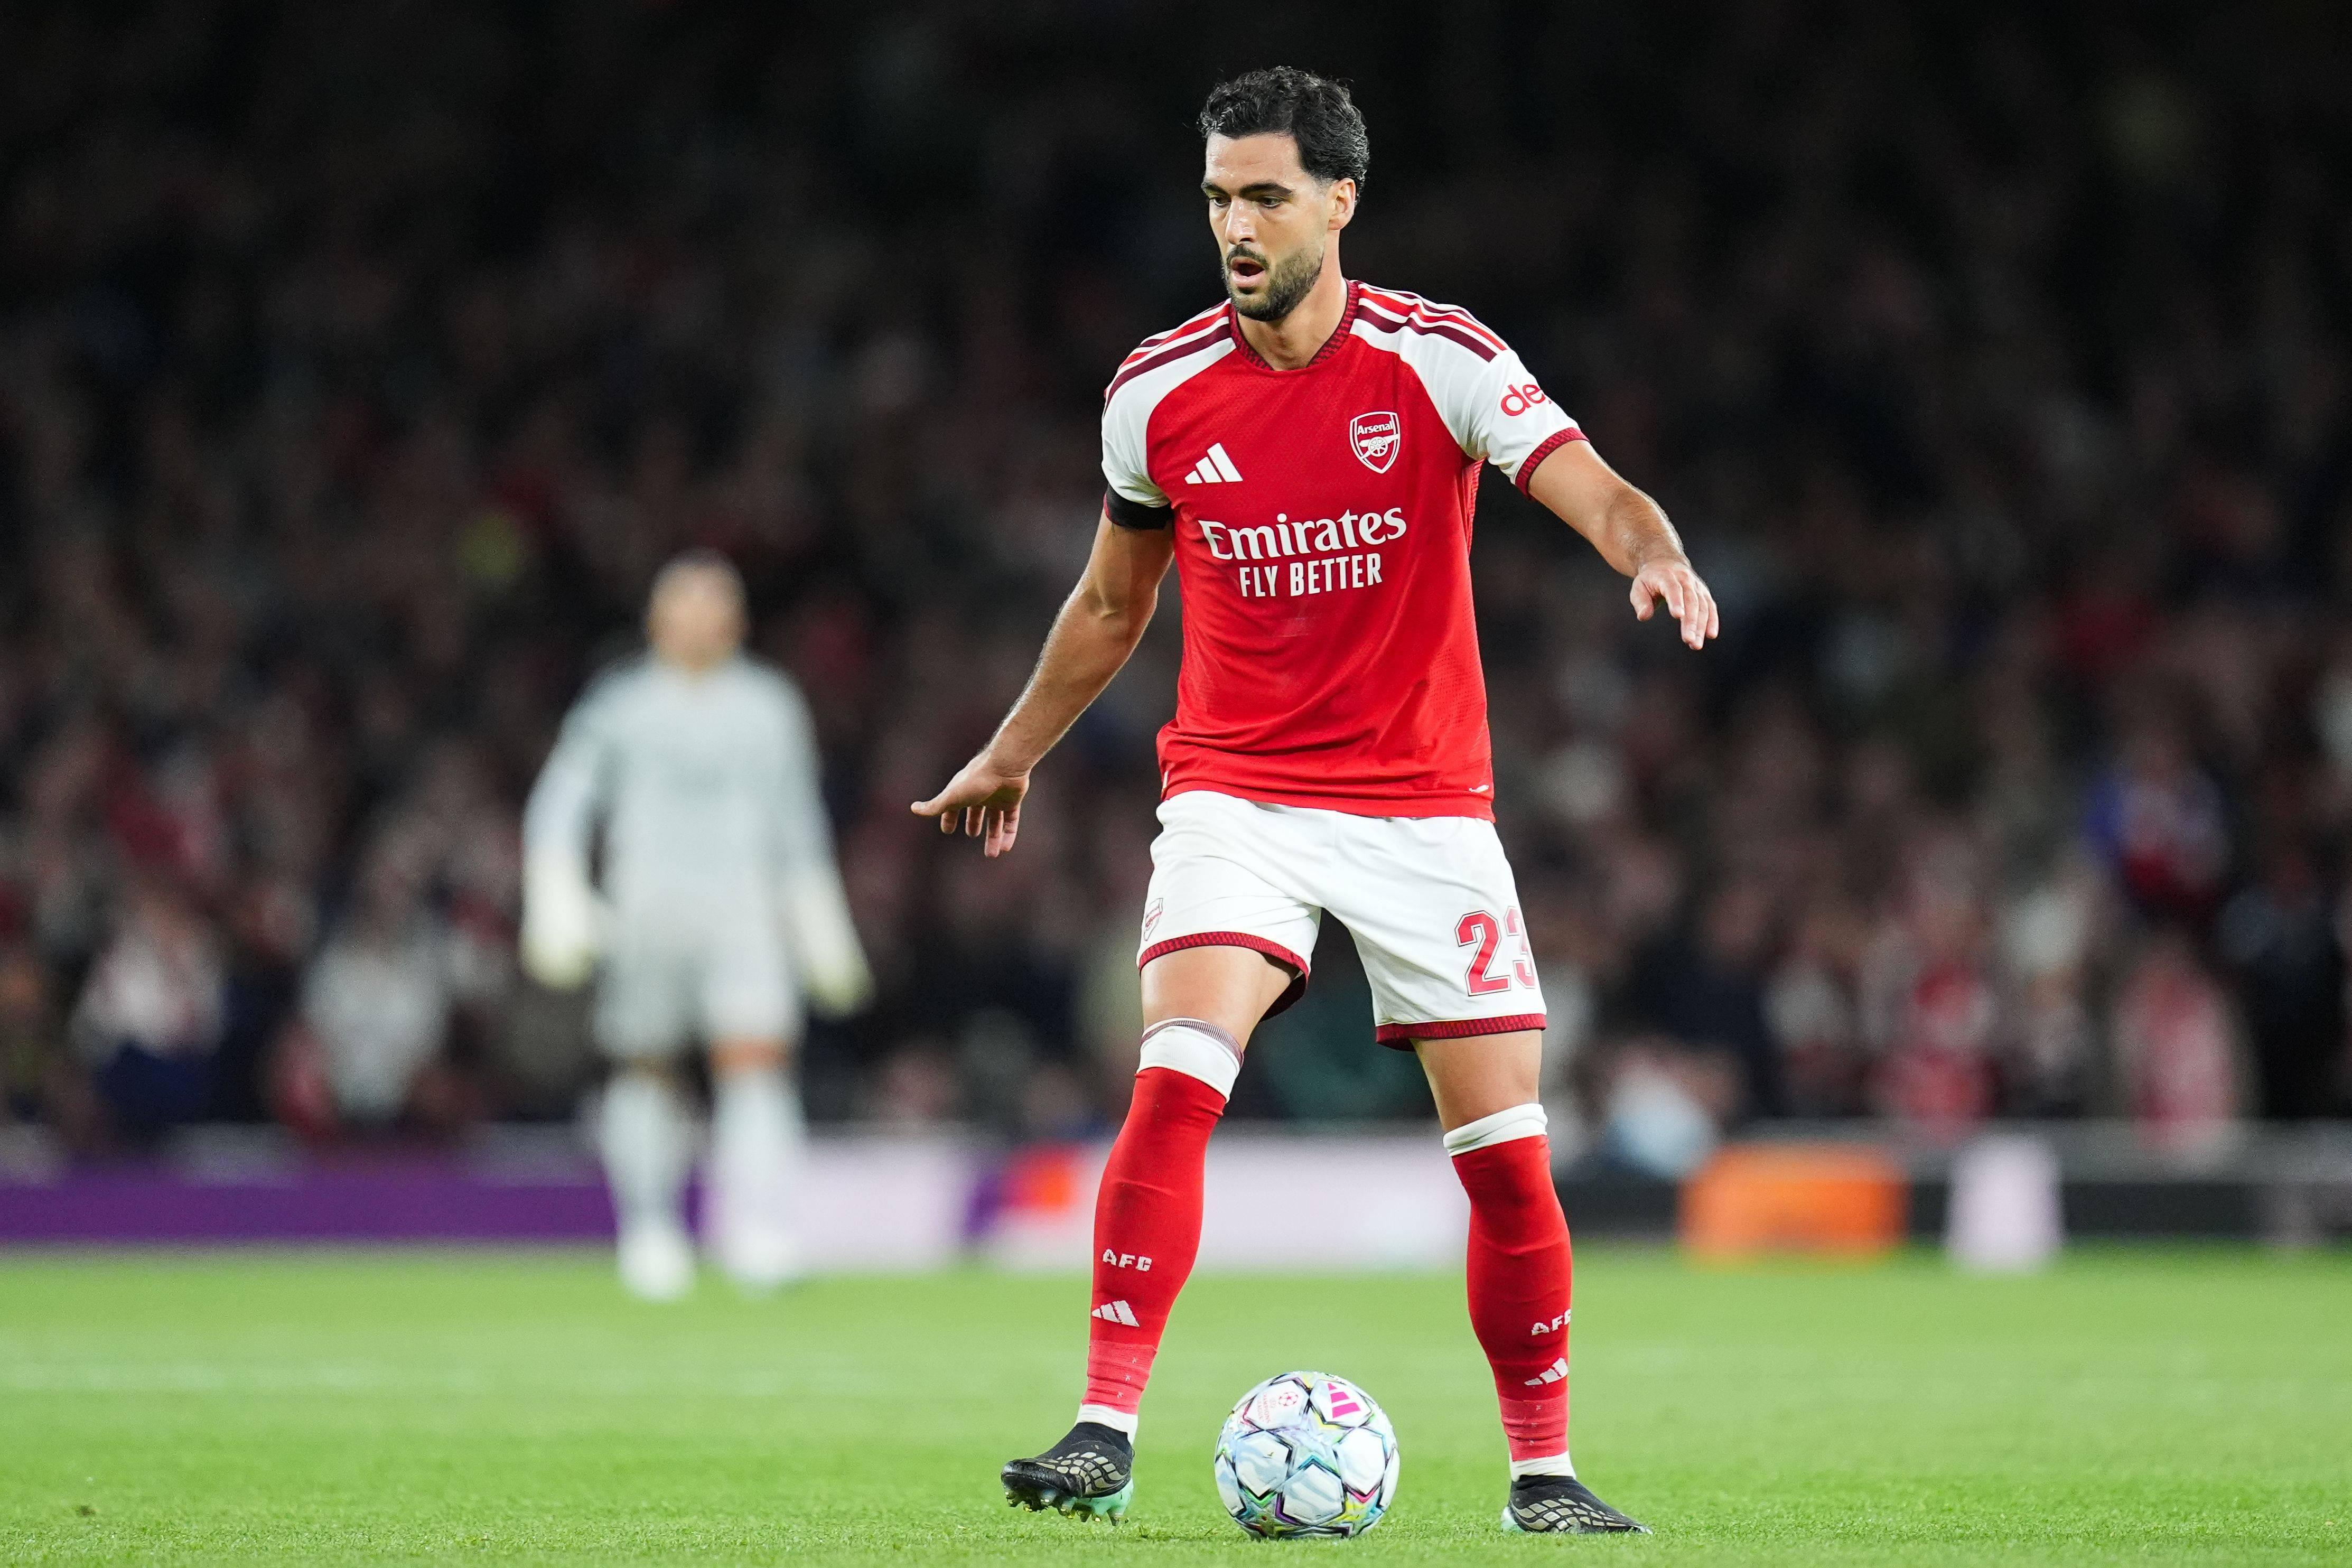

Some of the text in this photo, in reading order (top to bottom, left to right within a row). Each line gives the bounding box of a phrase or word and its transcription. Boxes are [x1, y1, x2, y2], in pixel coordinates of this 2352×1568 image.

[1501, 384, 1552, 416] de
[1357, 421, 1394, 435] Arsenal
[1198, 507, 1407, 560] Emirates
[1239, 553, 1382, 597] FLY BETTER
[1454, 906, 1536, 996] 23
[1102, 1248, 1152, 1272] AFC
